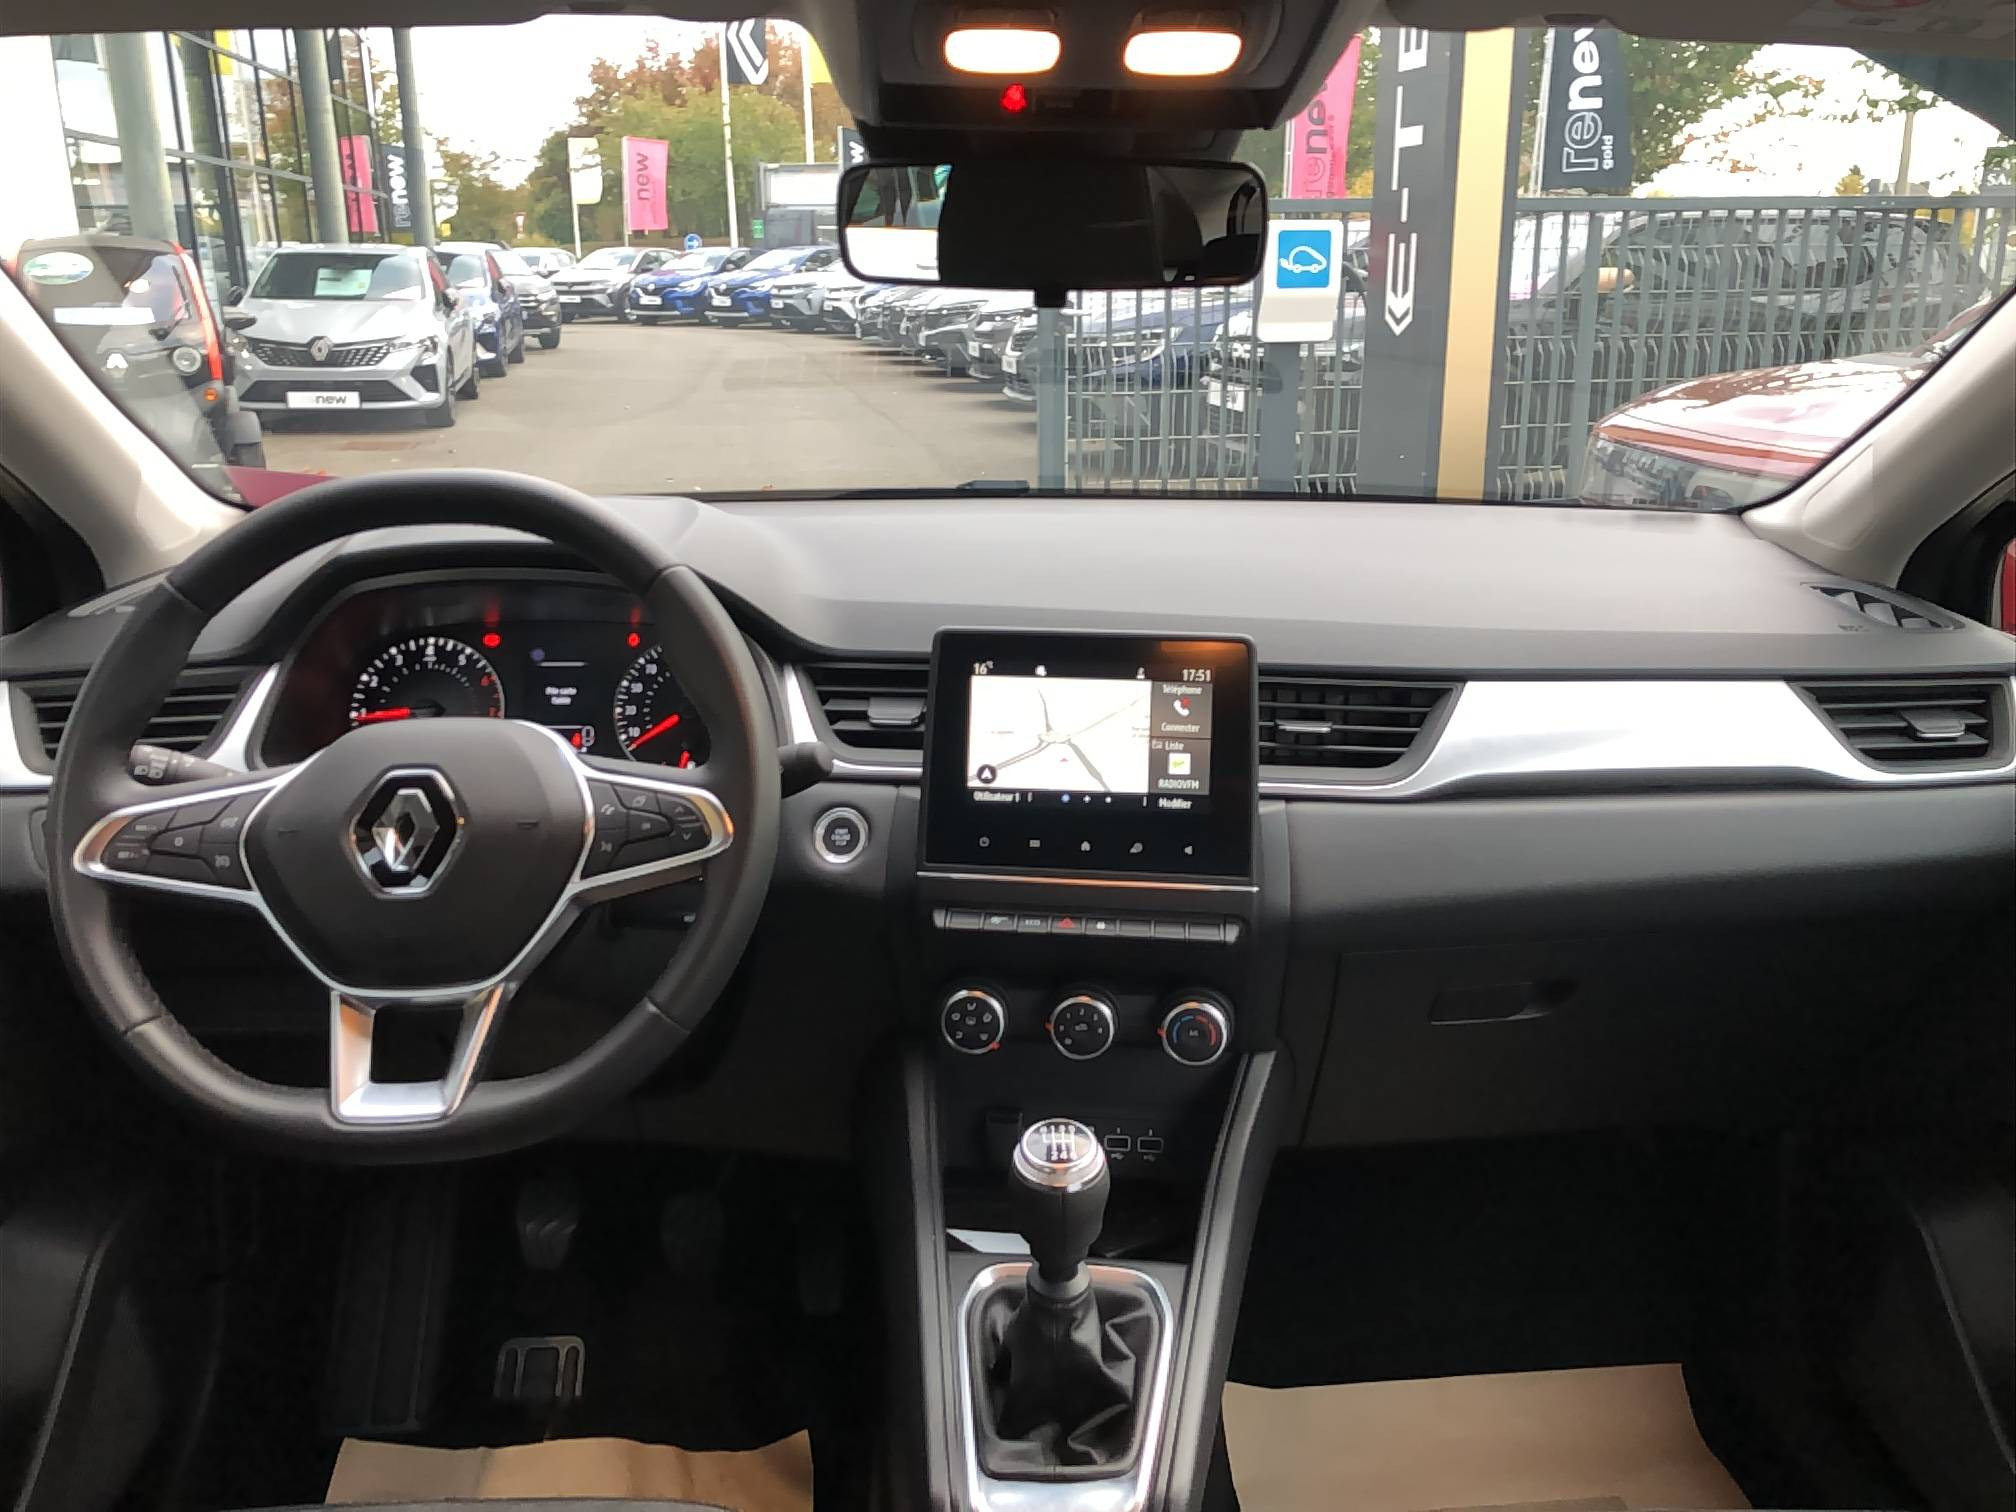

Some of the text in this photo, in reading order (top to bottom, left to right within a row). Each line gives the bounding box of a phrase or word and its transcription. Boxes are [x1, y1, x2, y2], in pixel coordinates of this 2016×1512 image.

[1302, 81, 1329, 198] rene
[1601, 134, 1614, 170] gold
[635, 152, 650, 202] new
[314, 395, 347, 405] new
